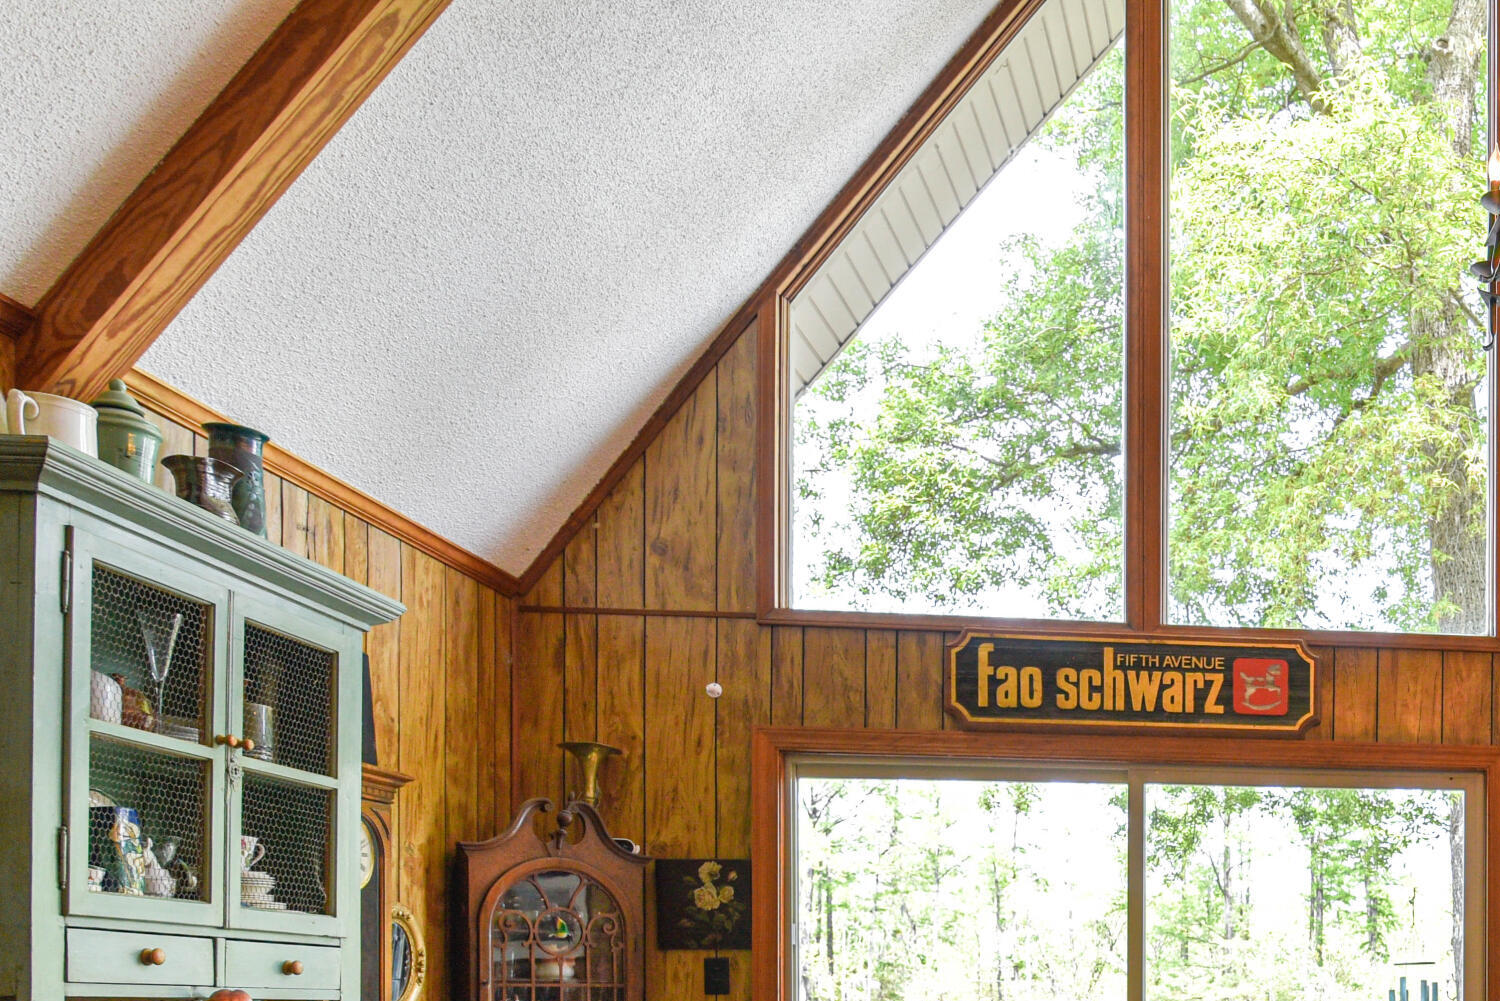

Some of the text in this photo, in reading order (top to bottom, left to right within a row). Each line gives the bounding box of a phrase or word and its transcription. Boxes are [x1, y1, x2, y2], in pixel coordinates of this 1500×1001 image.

[978, 642, 1225, 714] fao schwarz
[1116, 653, 1225, 670] FIFTH AVENUE
